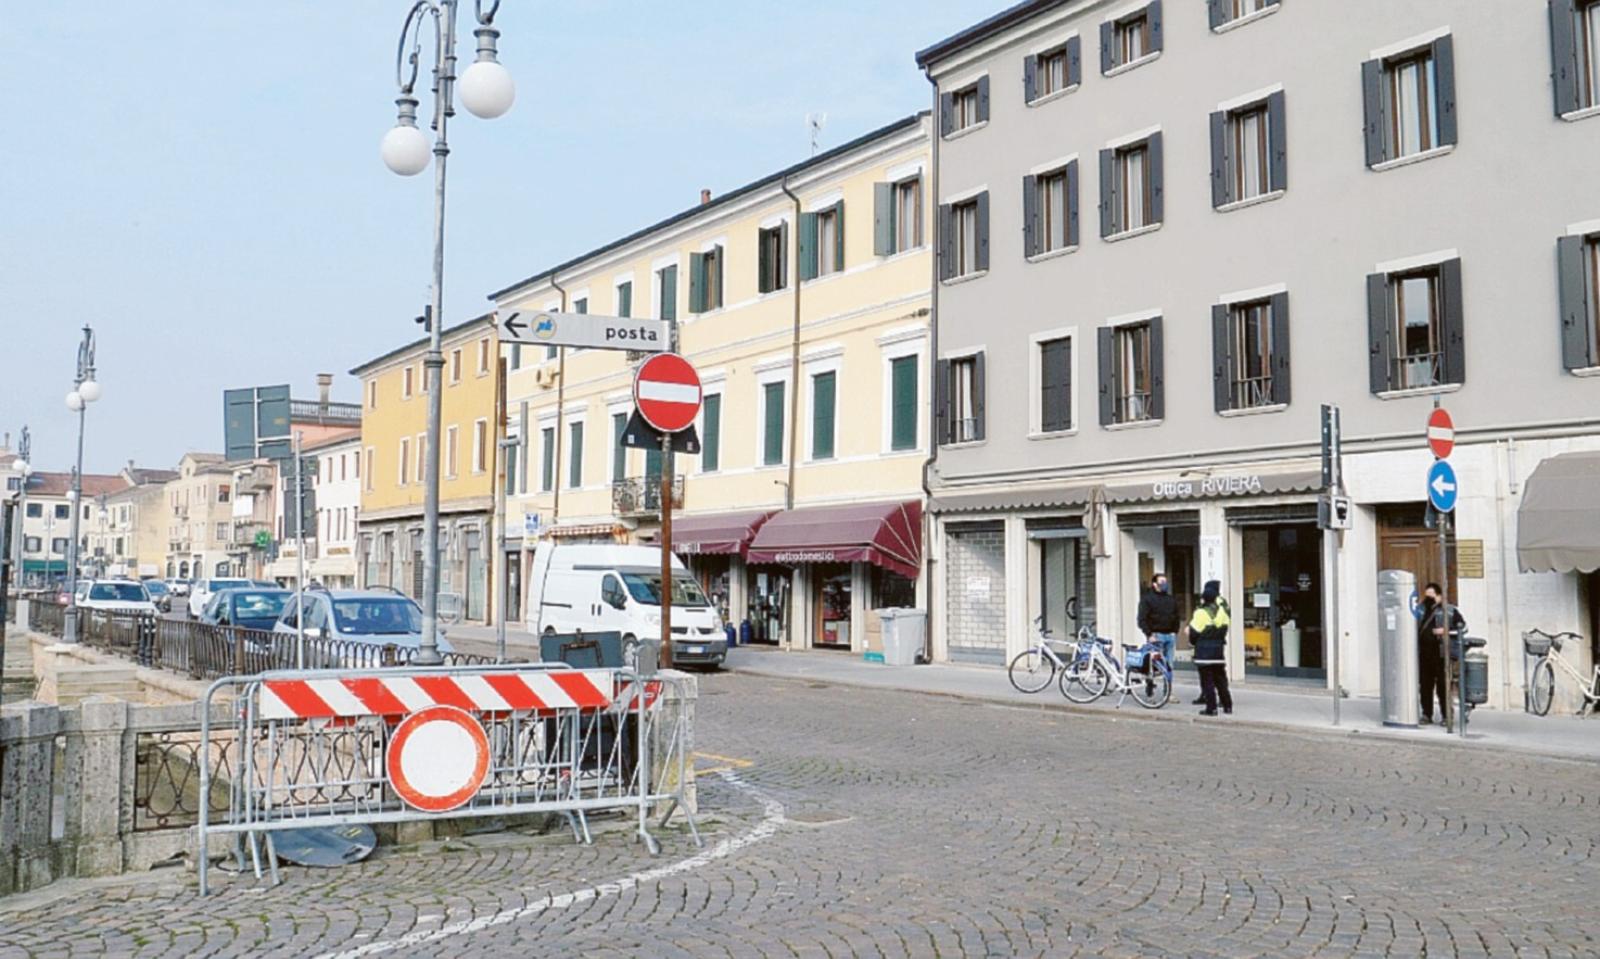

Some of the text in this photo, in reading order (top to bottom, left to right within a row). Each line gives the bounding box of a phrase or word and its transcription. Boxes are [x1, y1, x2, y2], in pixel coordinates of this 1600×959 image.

[605, 326, 657, 341] posta
[1153, 475, 1262, 496] Ottica RIVIERA
